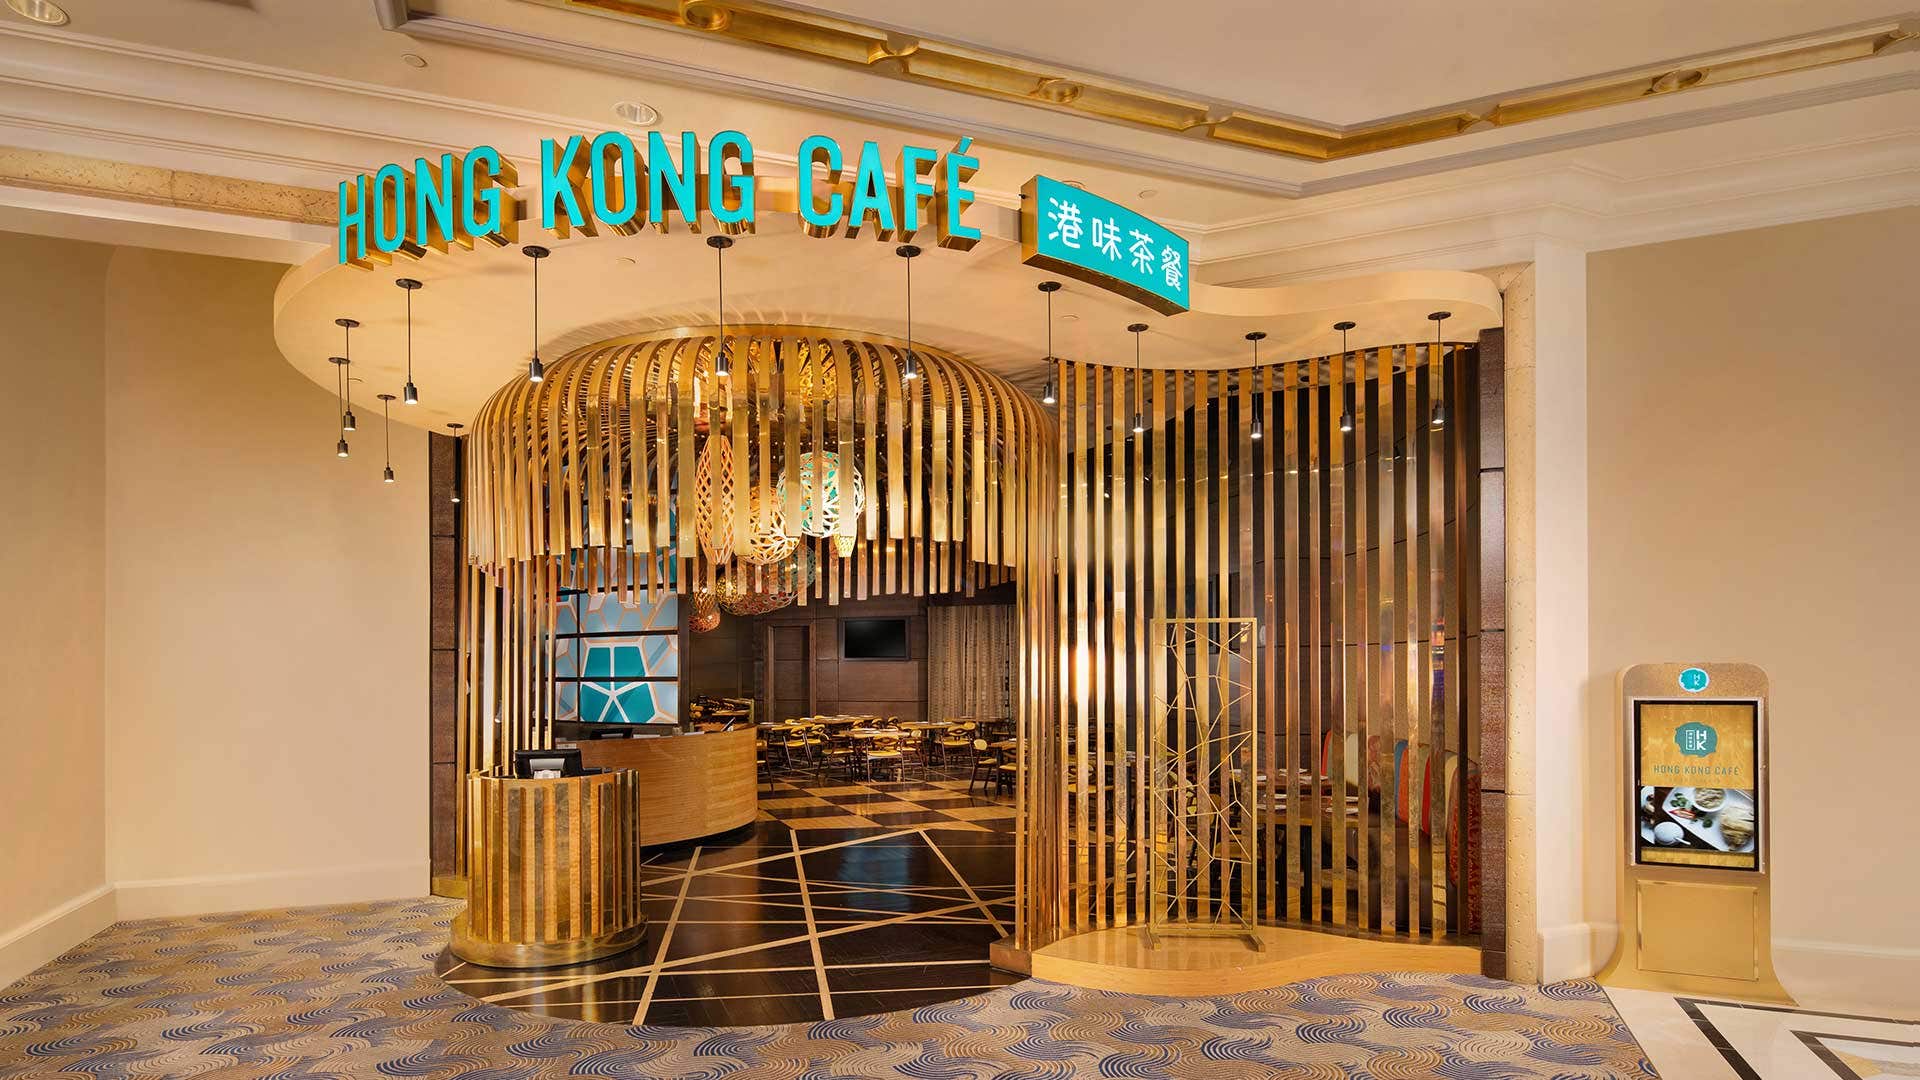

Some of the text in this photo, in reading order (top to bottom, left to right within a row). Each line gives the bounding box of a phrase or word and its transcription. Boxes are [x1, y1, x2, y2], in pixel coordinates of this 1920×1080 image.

[339, 130, 982, 264] HONG KONG CAFÉ
[1047, 197, 1184, 292] 港味茶餐
[1653, 764, 1680, 775] HONG
[1684, 765, 1711, 775] KONG
